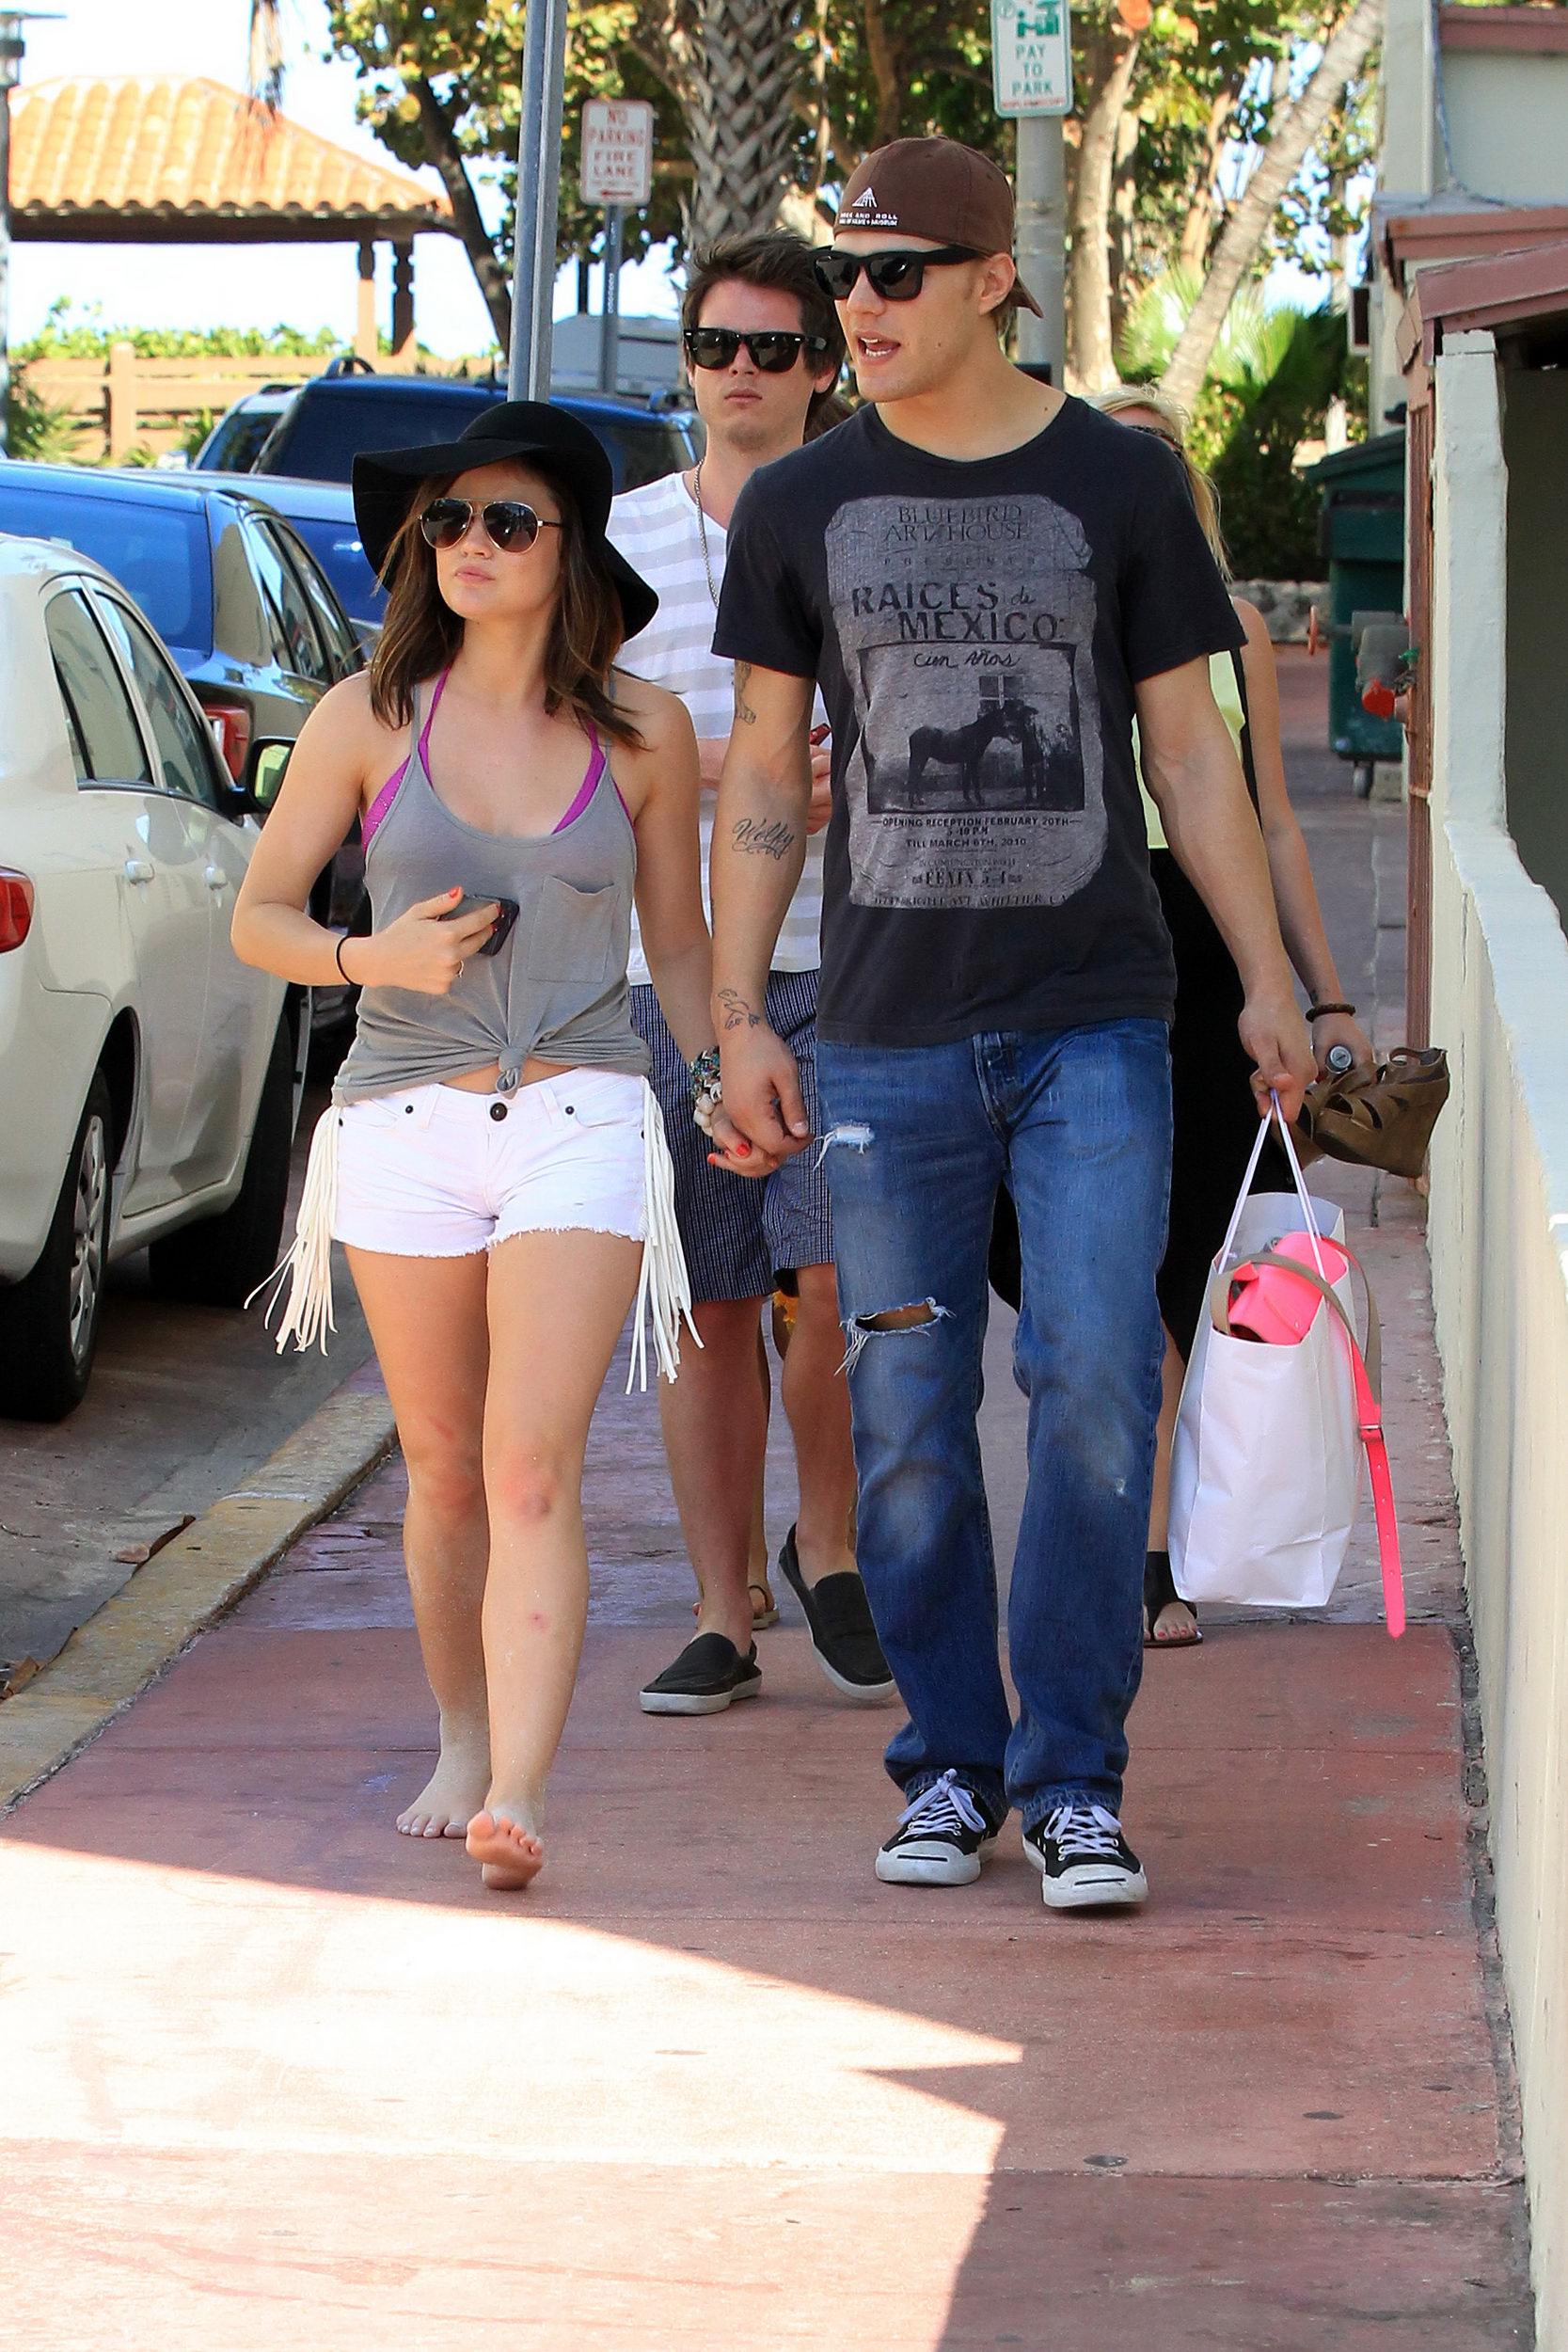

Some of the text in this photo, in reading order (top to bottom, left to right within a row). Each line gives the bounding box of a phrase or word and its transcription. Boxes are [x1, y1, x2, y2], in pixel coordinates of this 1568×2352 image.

[1016, 44, 1046, 58] PAY
[1023, 61, 1043, 77] TO
[1012, 81, 1053, 96] PARK
[608, 108, 627, 125] NO
[588, 128, 645, 147] PARKING
[594, 151, 633, 163] FIRE
[594, 167, 633, 177] LANE
[897, 505, 1022, 524] BLUEBIRD
[852, 581, 1035, 616] RAICES de
[883, 817, 1069, 827] OPENING RECEPTION FEBRUARY 20TH
[906, 838, 926, 848] TILL
[929, 837, 970, 848] MARCH
[1001, 837, 1027, 847] 2010
